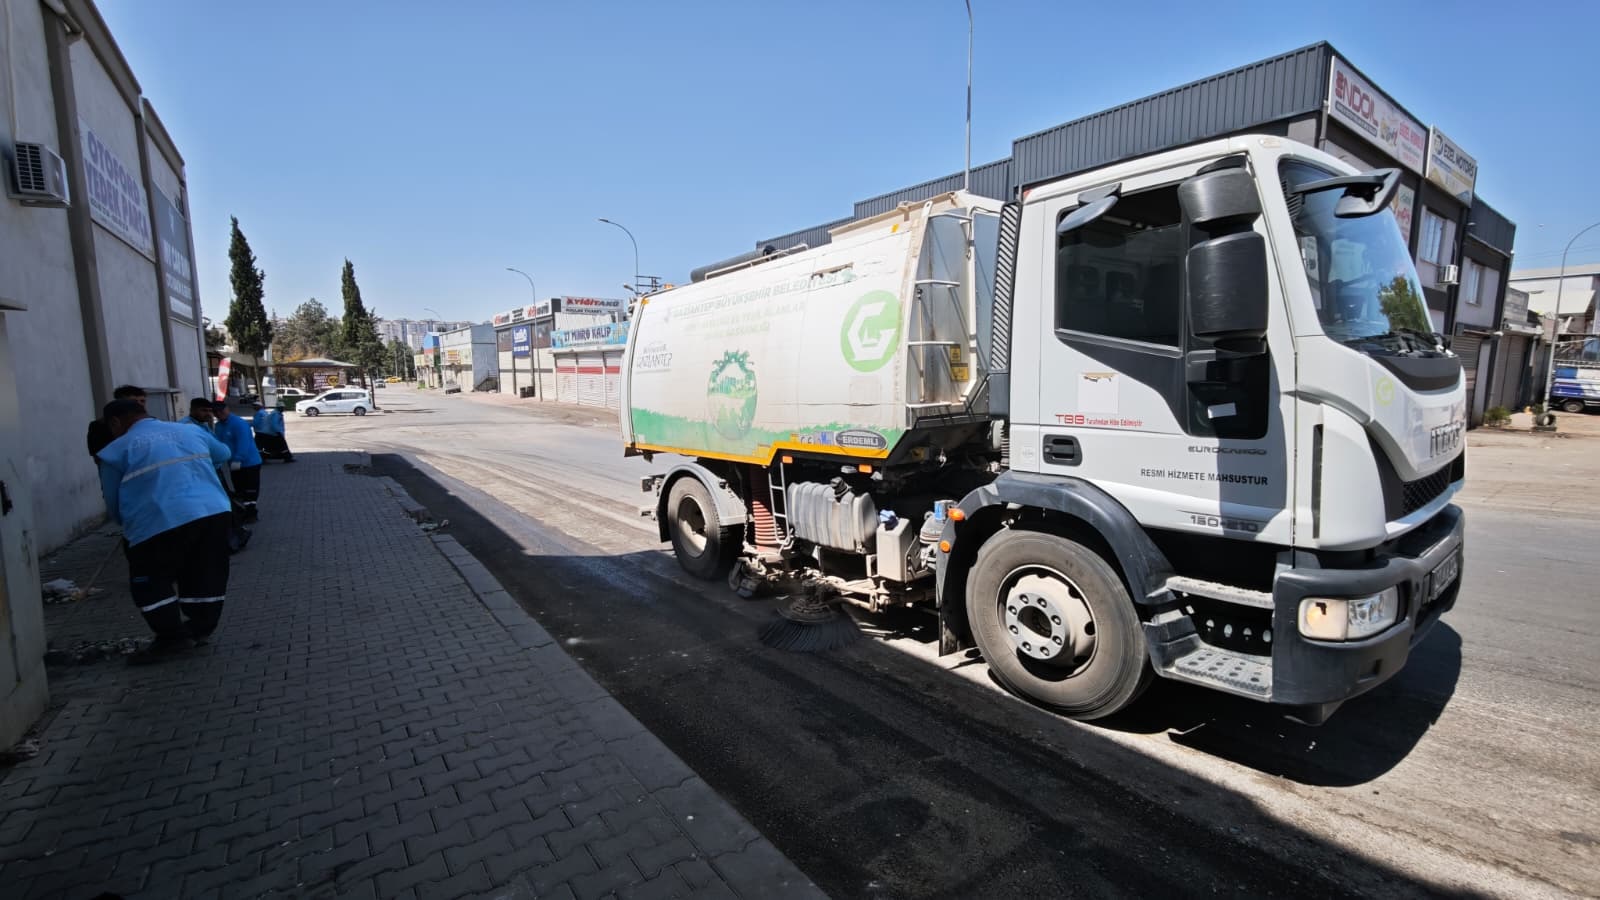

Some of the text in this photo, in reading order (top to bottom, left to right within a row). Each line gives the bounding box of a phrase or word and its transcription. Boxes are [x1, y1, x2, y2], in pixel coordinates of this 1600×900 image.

[85, 159, 121, 220] YEDEK
[1188, 445, 1268, 456] EUROCARGO
[1140, 468, 1269, 486] RESMİ HİZMETE MAHSUSTUR
